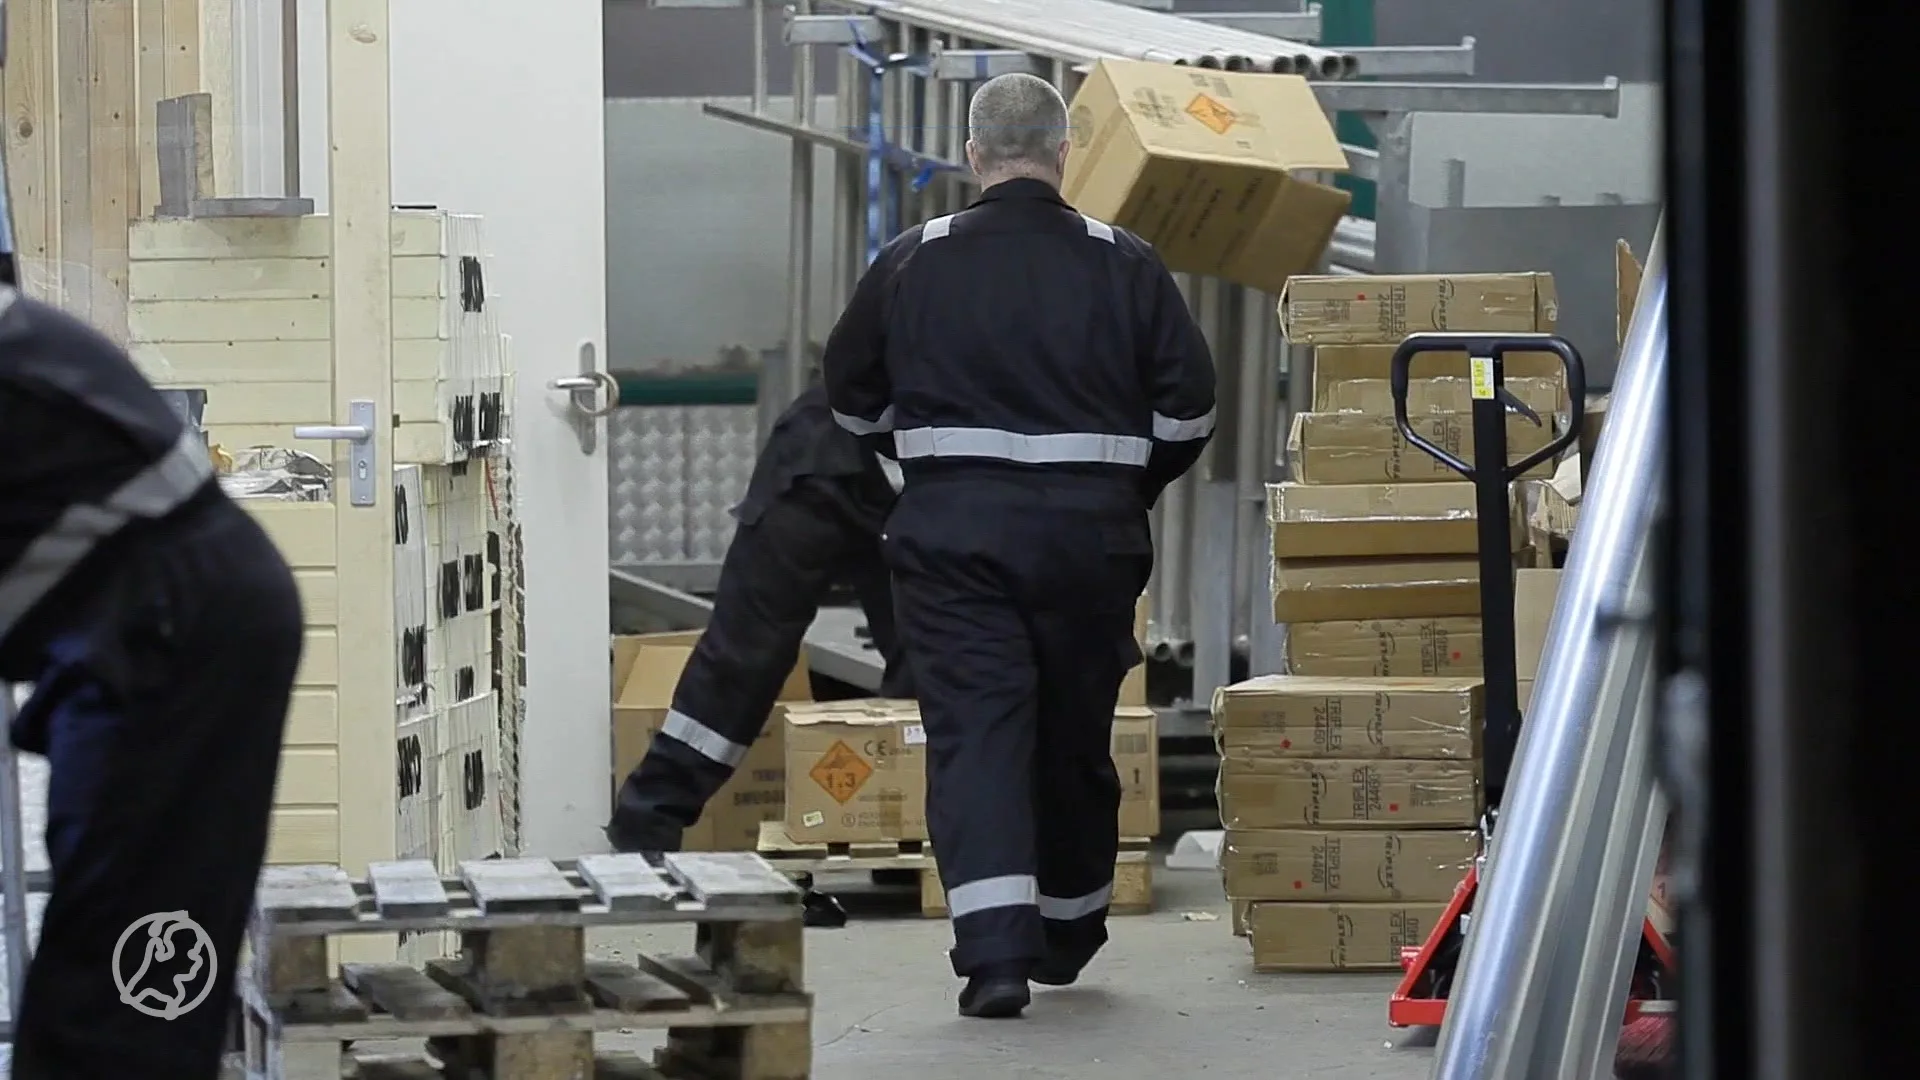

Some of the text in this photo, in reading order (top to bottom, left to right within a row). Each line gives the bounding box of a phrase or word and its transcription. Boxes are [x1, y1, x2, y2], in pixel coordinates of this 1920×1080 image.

[1393, 285, 1406, 337] TRIPLEX
[1421, 623, 1433, 674] TRIPLEX
[1313, 706, 1325, 744] 24460
[1329, 699, 1342, 751] TRIPLEX
[825, 771, 857, 789] 1.3
[1352, 767, 1365, 818] TRIPLEX
[1369, 773, 1382, 811] 24460
[1311, 845, 1324, 884] 24460
[1328, 837, 1340, 890] TRIPLEX
